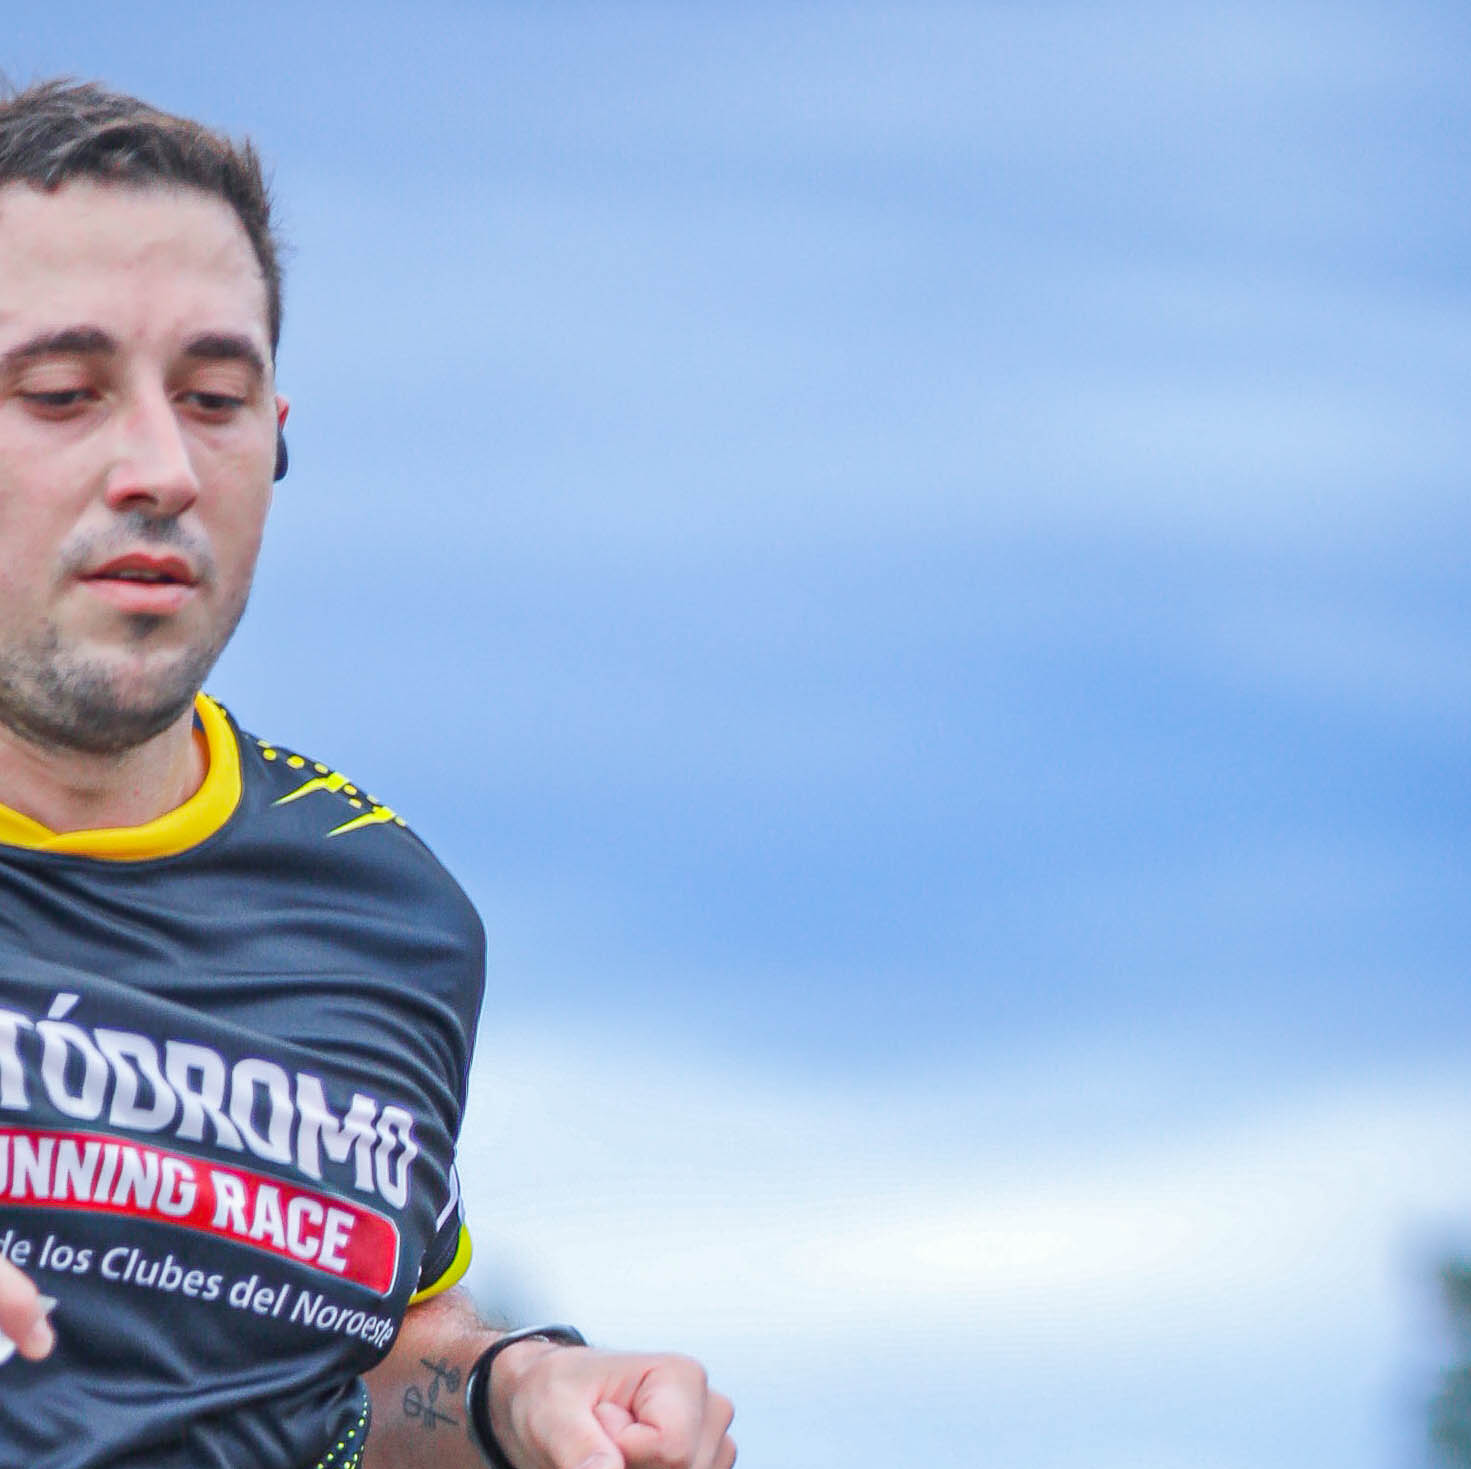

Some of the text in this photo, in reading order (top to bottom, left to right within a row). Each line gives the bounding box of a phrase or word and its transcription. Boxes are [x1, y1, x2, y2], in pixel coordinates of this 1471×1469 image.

[211, 1172, 357, 1275] RACE
[39, 1234, 93, 1273] los
[100, 1246, 223, 1301] Clubes
[229, 1274, 290, 1317] del
[289, 1290, 394, 1347] Noroeste
